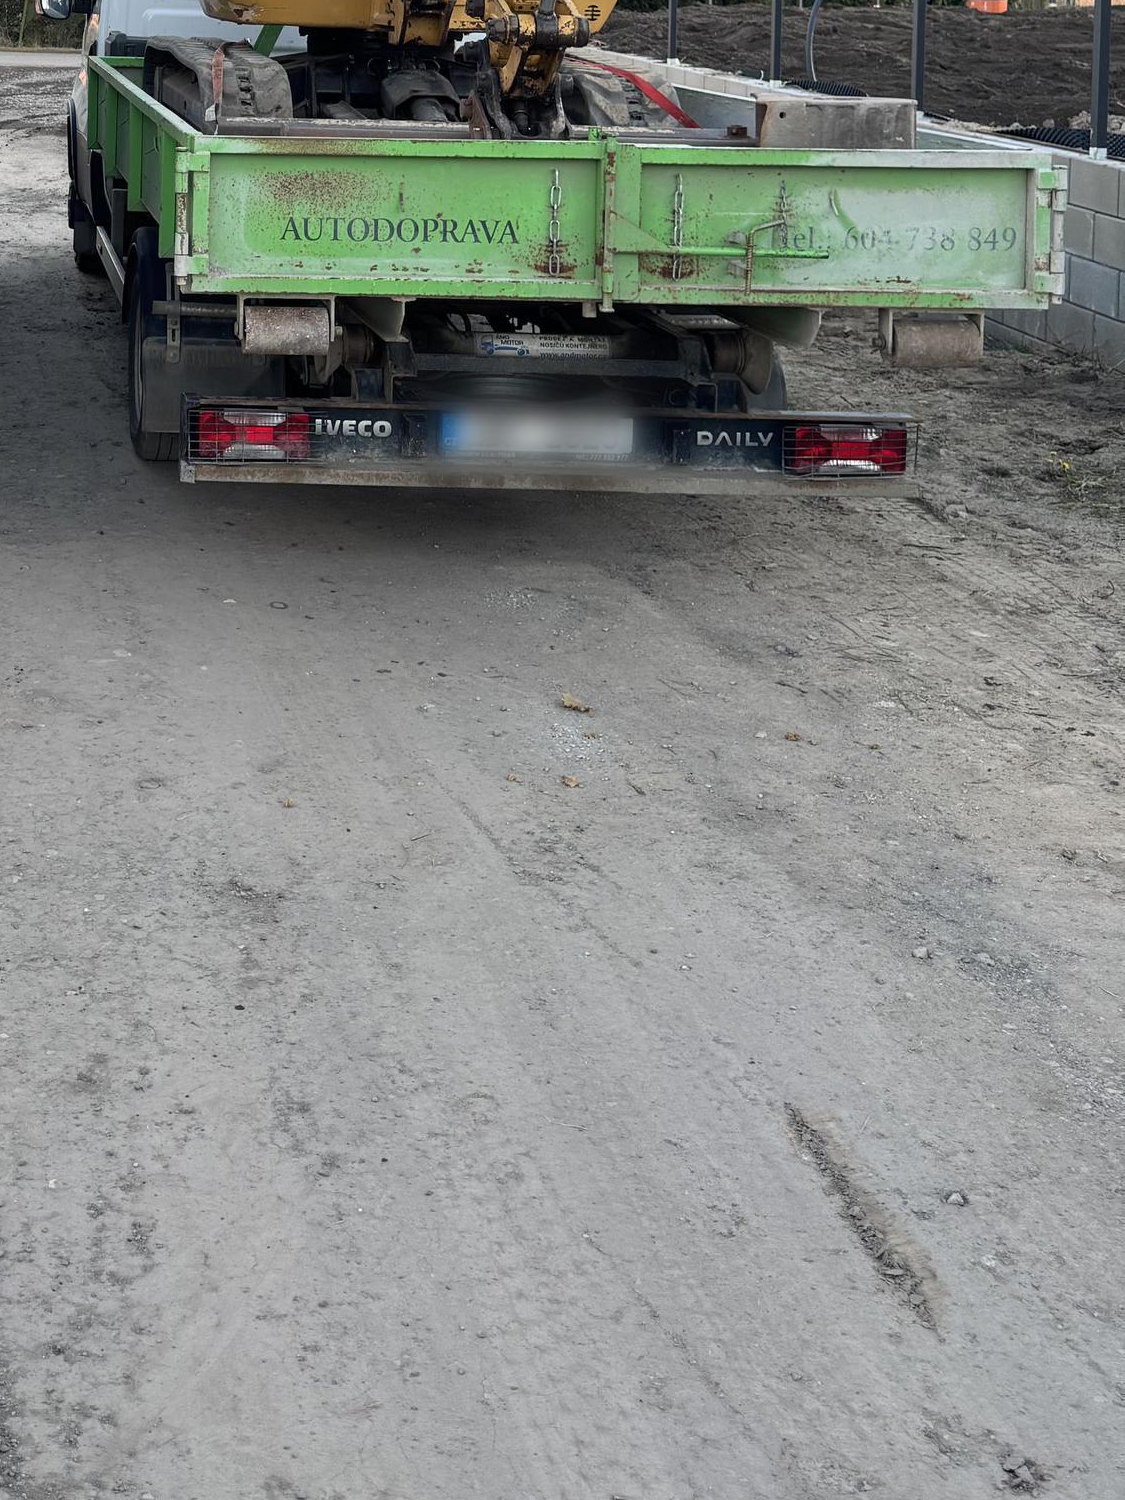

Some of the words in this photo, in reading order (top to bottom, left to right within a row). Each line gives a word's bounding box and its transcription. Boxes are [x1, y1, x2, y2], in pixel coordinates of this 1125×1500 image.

[279, 216, 520, 245] AUTODOPRAVA
[905, 226, 955, 251] 738
[967, 226, 1017, 251] 849
[314, 418, 393, 438] IVECO
[696, 430, 774, 447] DAILY
